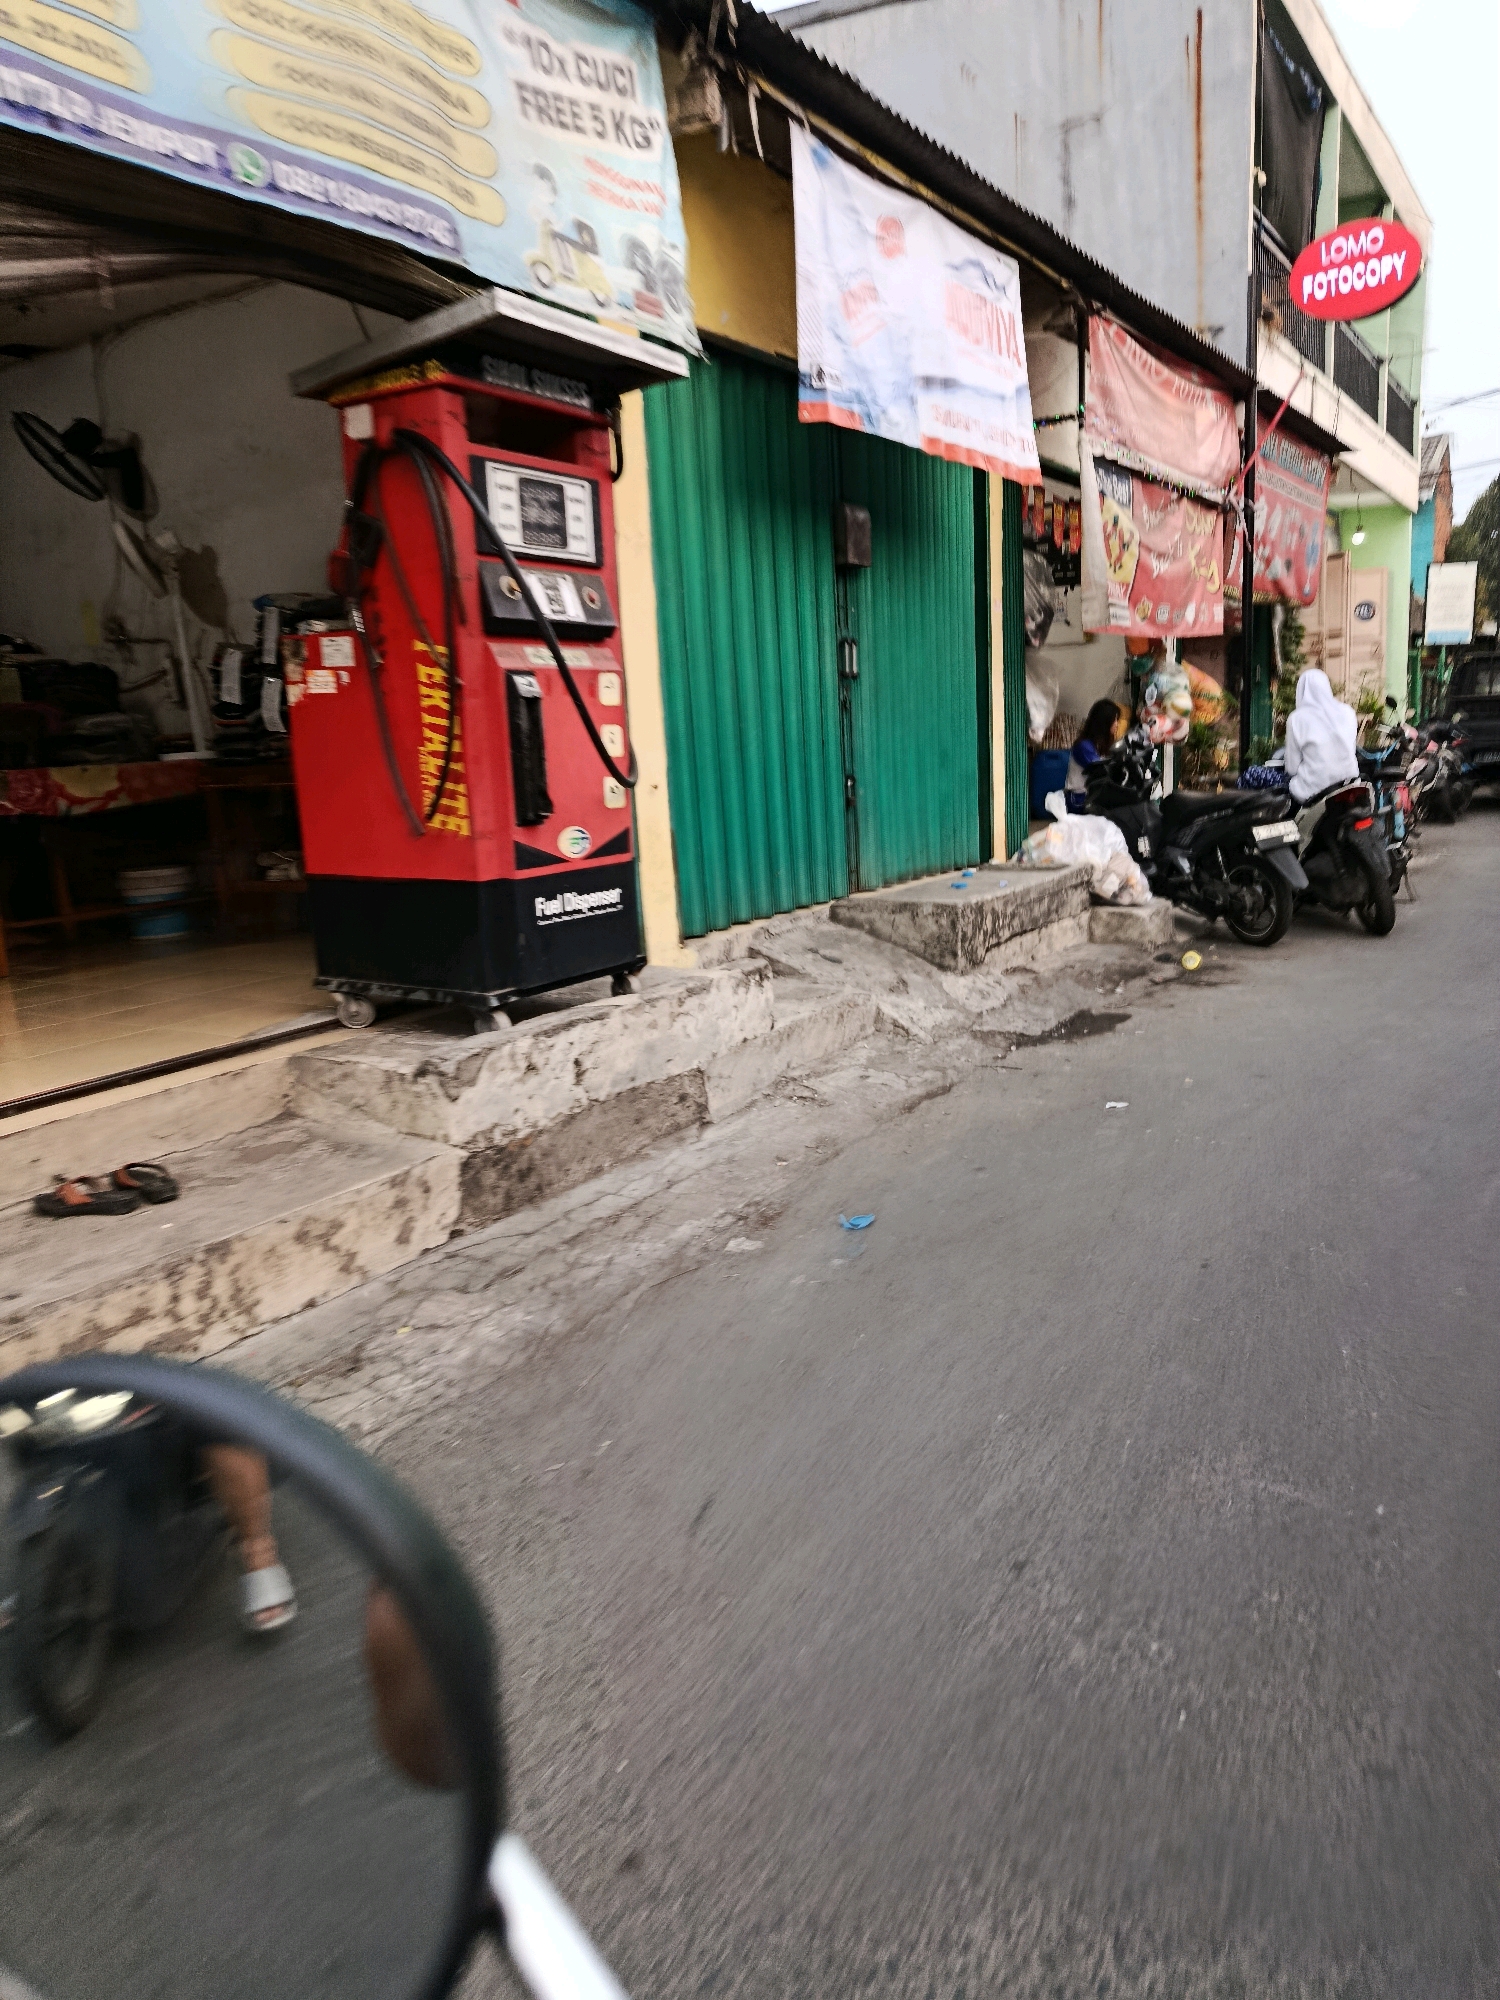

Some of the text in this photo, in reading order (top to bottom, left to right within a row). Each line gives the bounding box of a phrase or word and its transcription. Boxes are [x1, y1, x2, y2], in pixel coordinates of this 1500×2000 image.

[574, 50, 637, 101] CUCI
[514, 79, 586, 136] FREE
[589, 99, 607, 139] 5
[1321, 225, 1385, 267] LOMO
[1302, 250, 1407, 305] FOTOCOPY
[535, 897, 564, 917] Fuel
[563, 888, 623, 913] Dispenser
